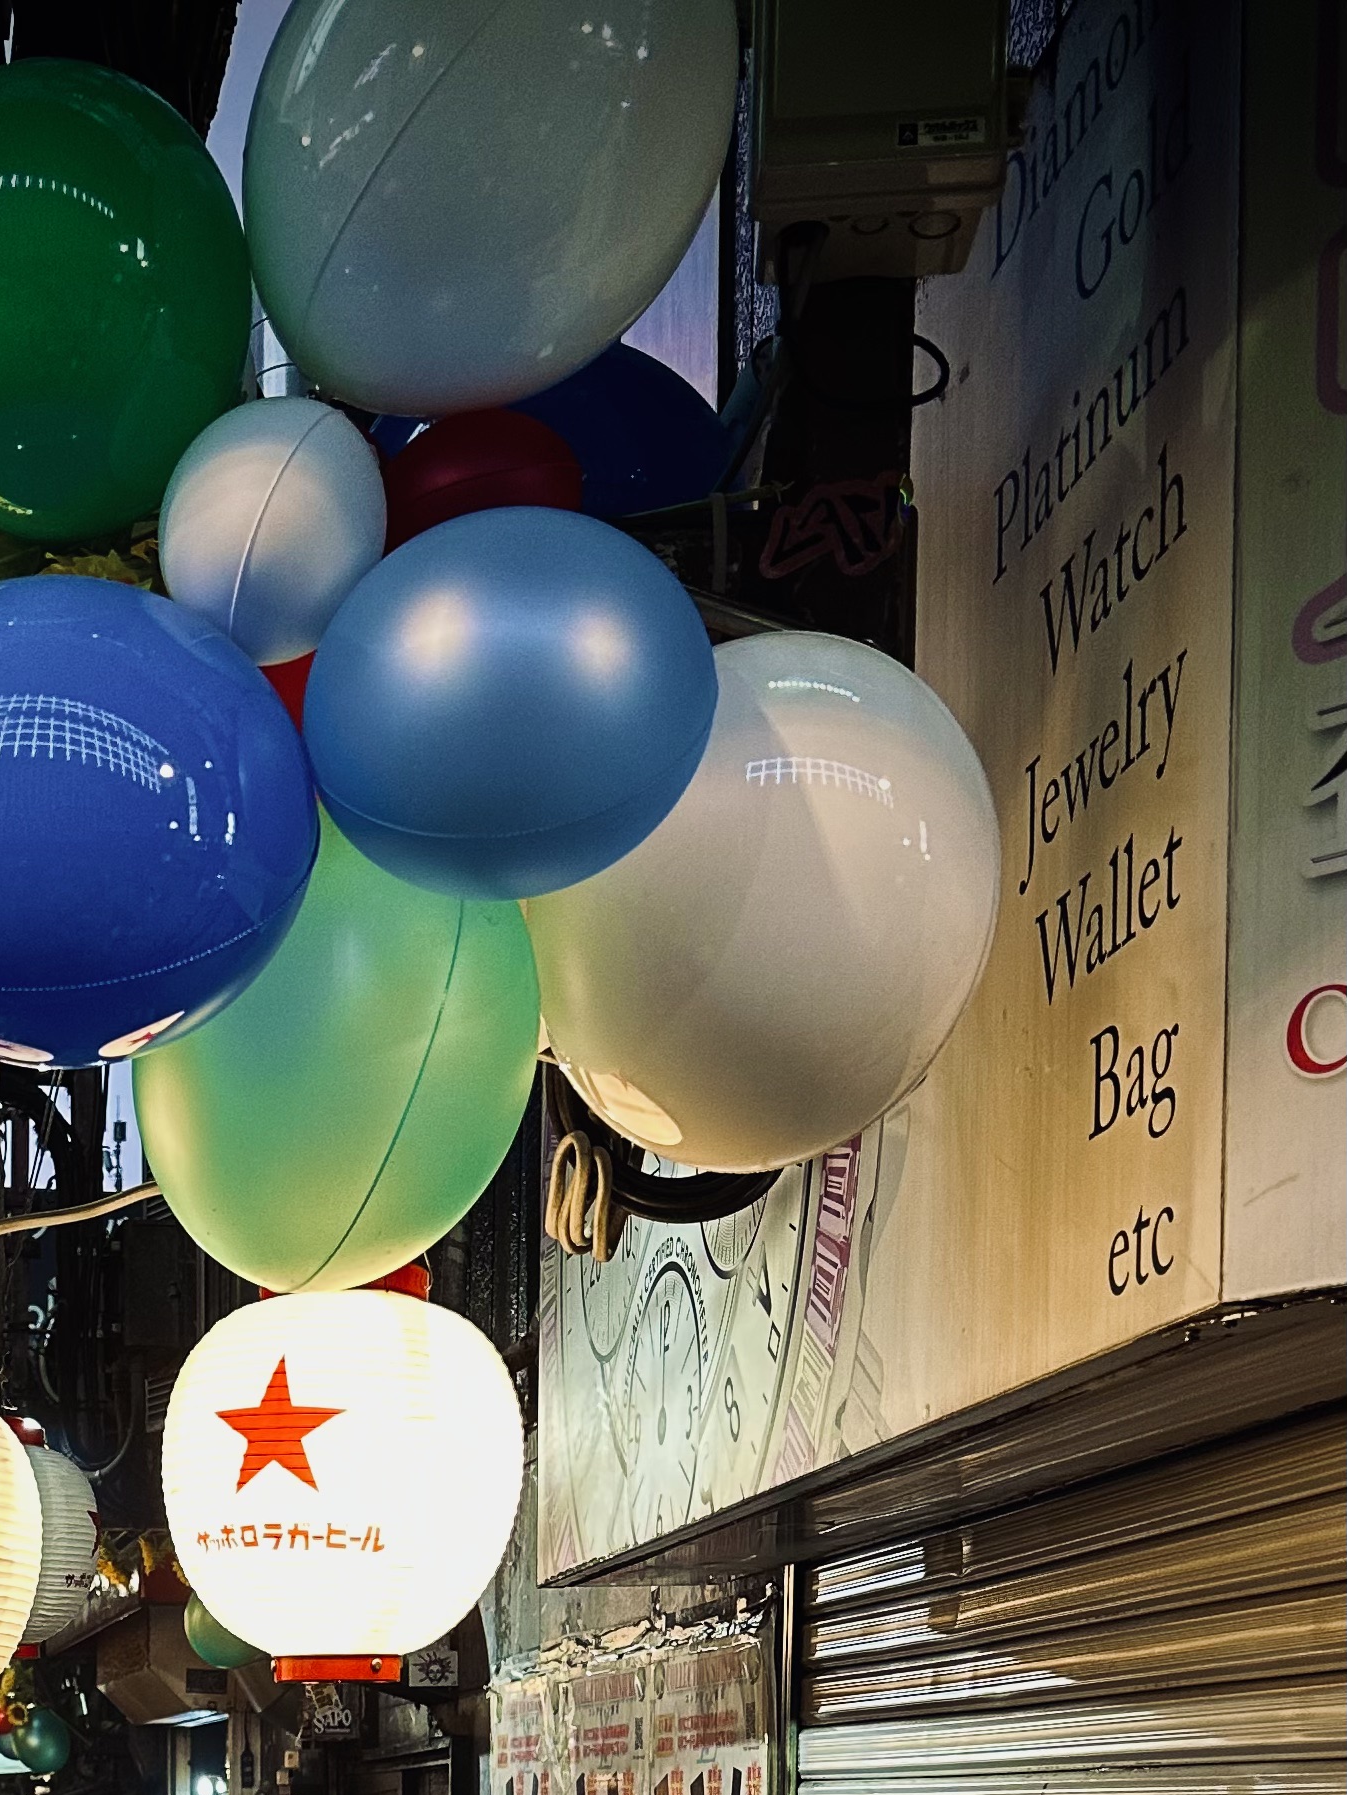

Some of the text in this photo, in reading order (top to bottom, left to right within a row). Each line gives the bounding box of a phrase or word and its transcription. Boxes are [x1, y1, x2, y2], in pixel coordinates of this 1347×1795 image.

[1075, 47, 1192, 299] Gold
[993, 286, 1190, 586] Platinum
[1040, 443, 1188, 677] Watch
[1019, 649, 1187, 895] Jewelry
[1035, 826, 1183, 1005] Wallet
[1088, 1022, 1179, 1141] Bag
[644, 1236, 674, 1293] CERTIFIED
[675, 1236, 709, 1367] CHRONOMETER
[1107, 1204, 1174, 1297] etc
